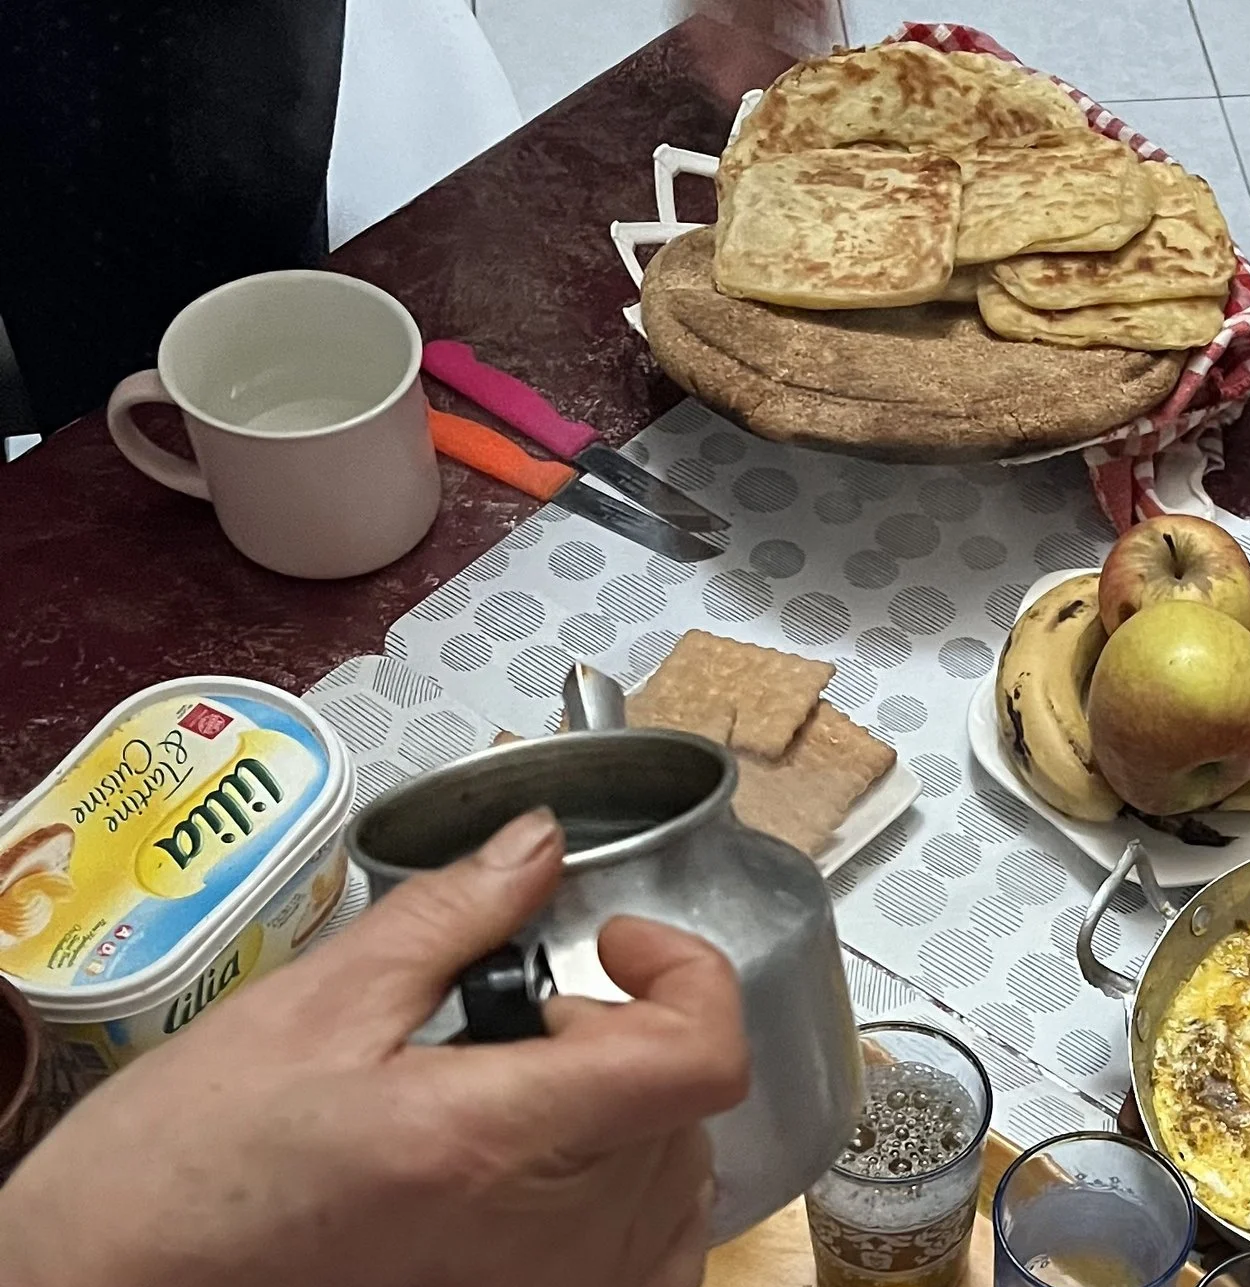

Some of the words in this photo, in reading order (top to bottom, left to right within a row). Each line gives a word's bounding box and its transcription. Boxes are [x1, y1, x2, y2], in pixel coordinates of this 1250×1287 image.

[70, 738, 153, 824] Cuisine
[157, 729, 189, 765] &
[105, 765, 194, 834] Tartine
[153, 757, 284, 870] lilia
[162, 950, 241, 1034] lilia
